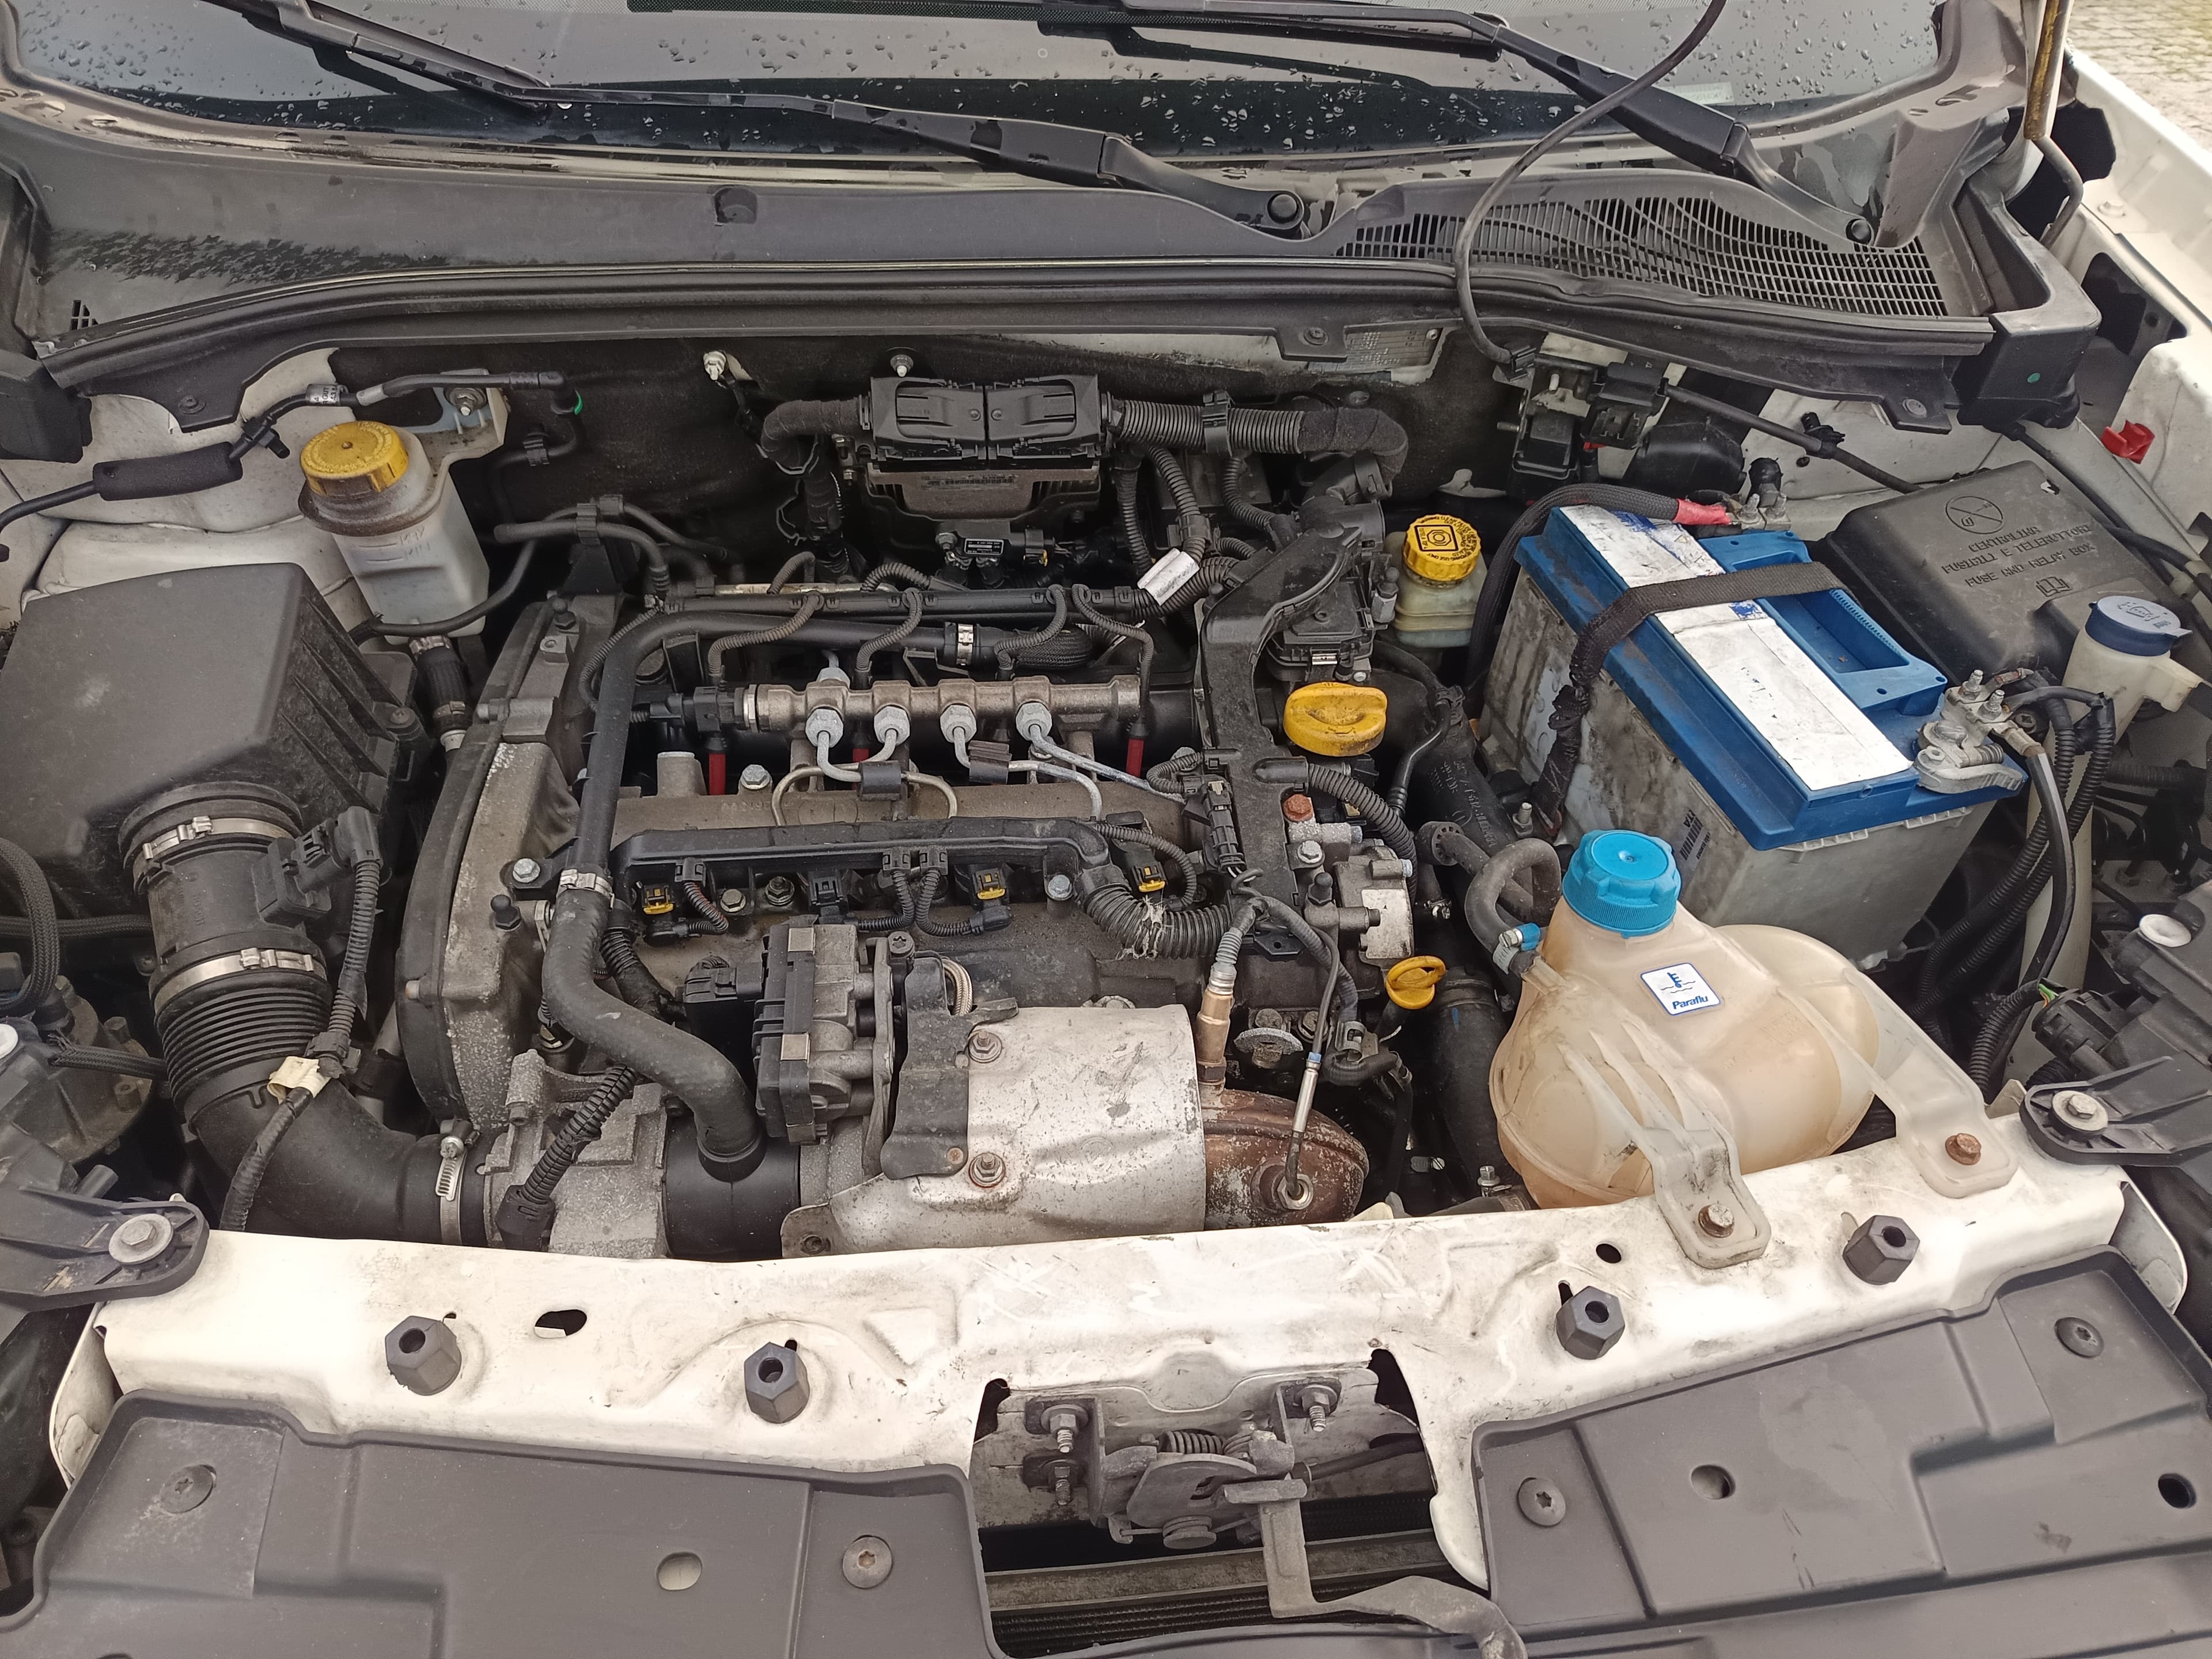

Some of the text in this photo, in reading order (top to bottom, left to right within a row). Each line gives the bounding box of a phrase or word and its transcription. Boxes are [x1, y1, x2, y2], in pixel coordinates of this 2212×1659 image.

[1941, 524, 2092, 574] FUSIBILI E TELERUTTORI
[1968, 526, 2041, 552] CENTRALINA
[1964, 542, 2096, 587] FUSE AND RELAY BOX
[1672, 995, 1709, 1010] Paraflu
